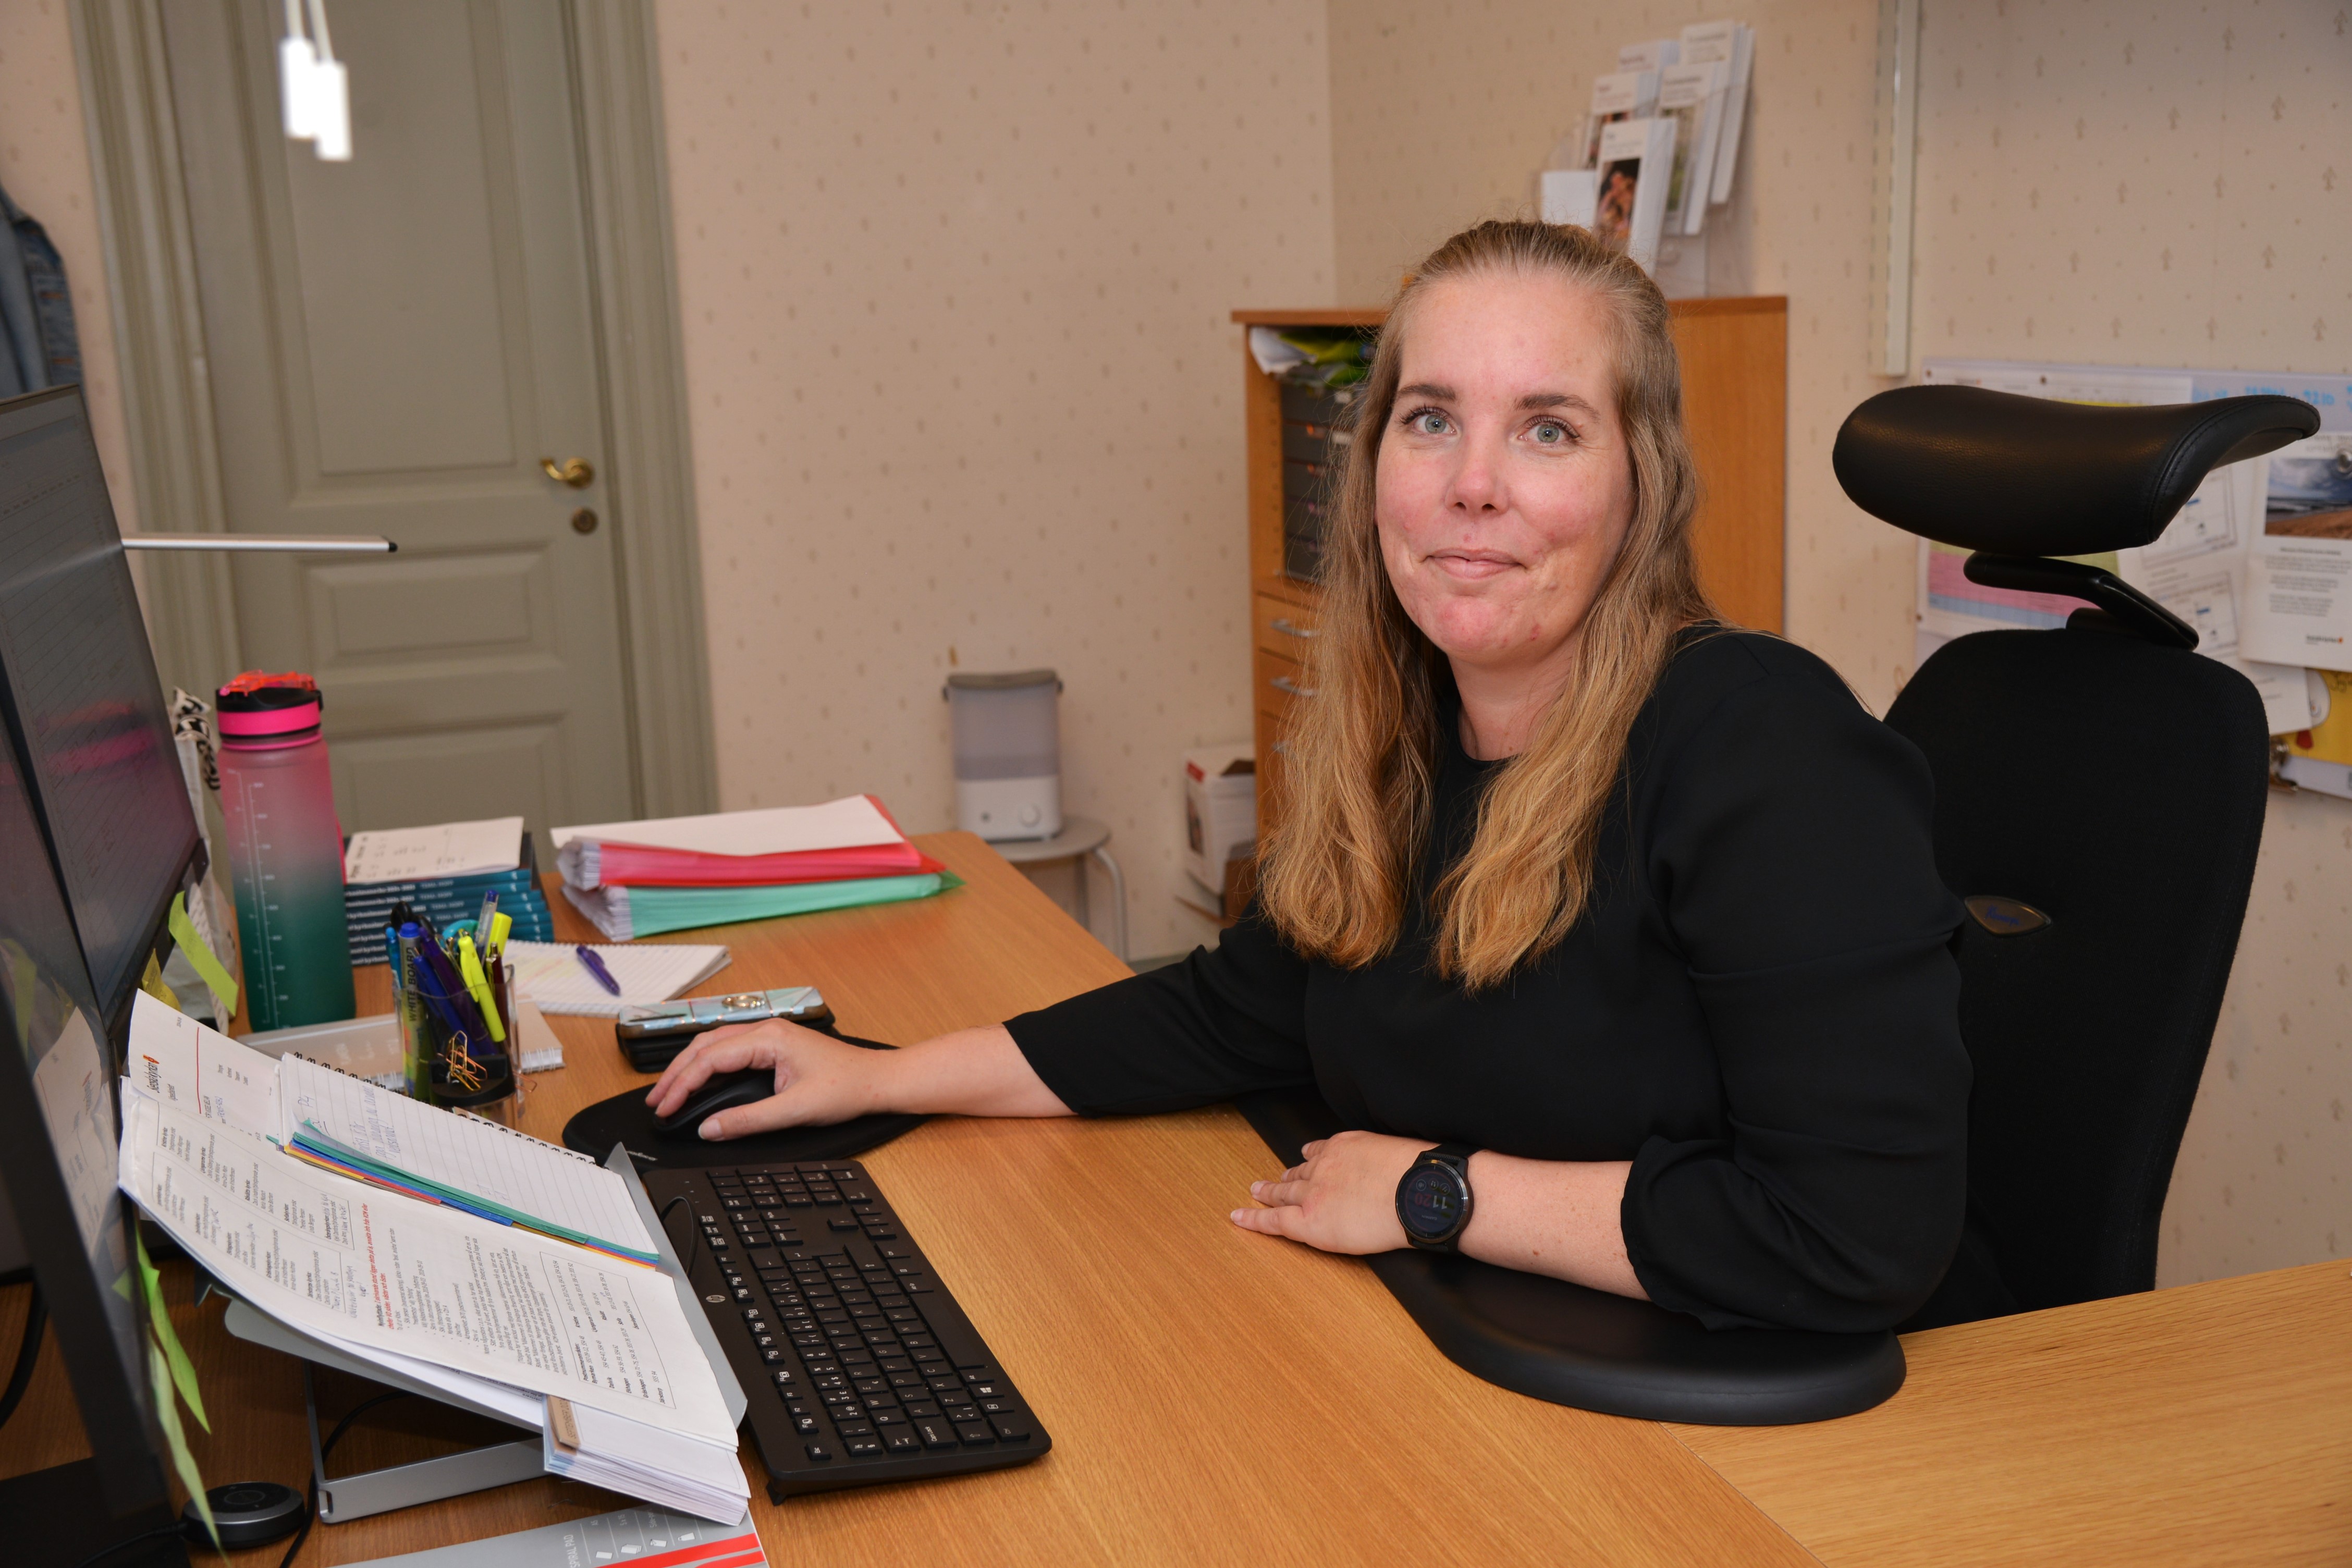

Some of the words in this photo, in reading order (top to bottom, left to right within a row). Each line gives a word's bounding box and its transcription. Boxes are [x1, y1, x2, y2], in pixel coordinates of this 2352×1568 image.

[145, 1061, 161, 1078] kyrkan
[147, 1076, 160, 1093] Svenska
[372, 1283, 381, 1301] skrivande
[375, 1304, 385, 1326] Nyinflyttade:
[589, 1365, 597, 1383] Bymarken
[607, 1377, 615, 1389] Dalvik
[623, 1378, 632, 1394] Ekhagen
[639, 1379, 648, 1398] Gräshagen
[564, 1534, 575, 1548] PAD
[567, 1546, 580, 1568] SPIRAL
